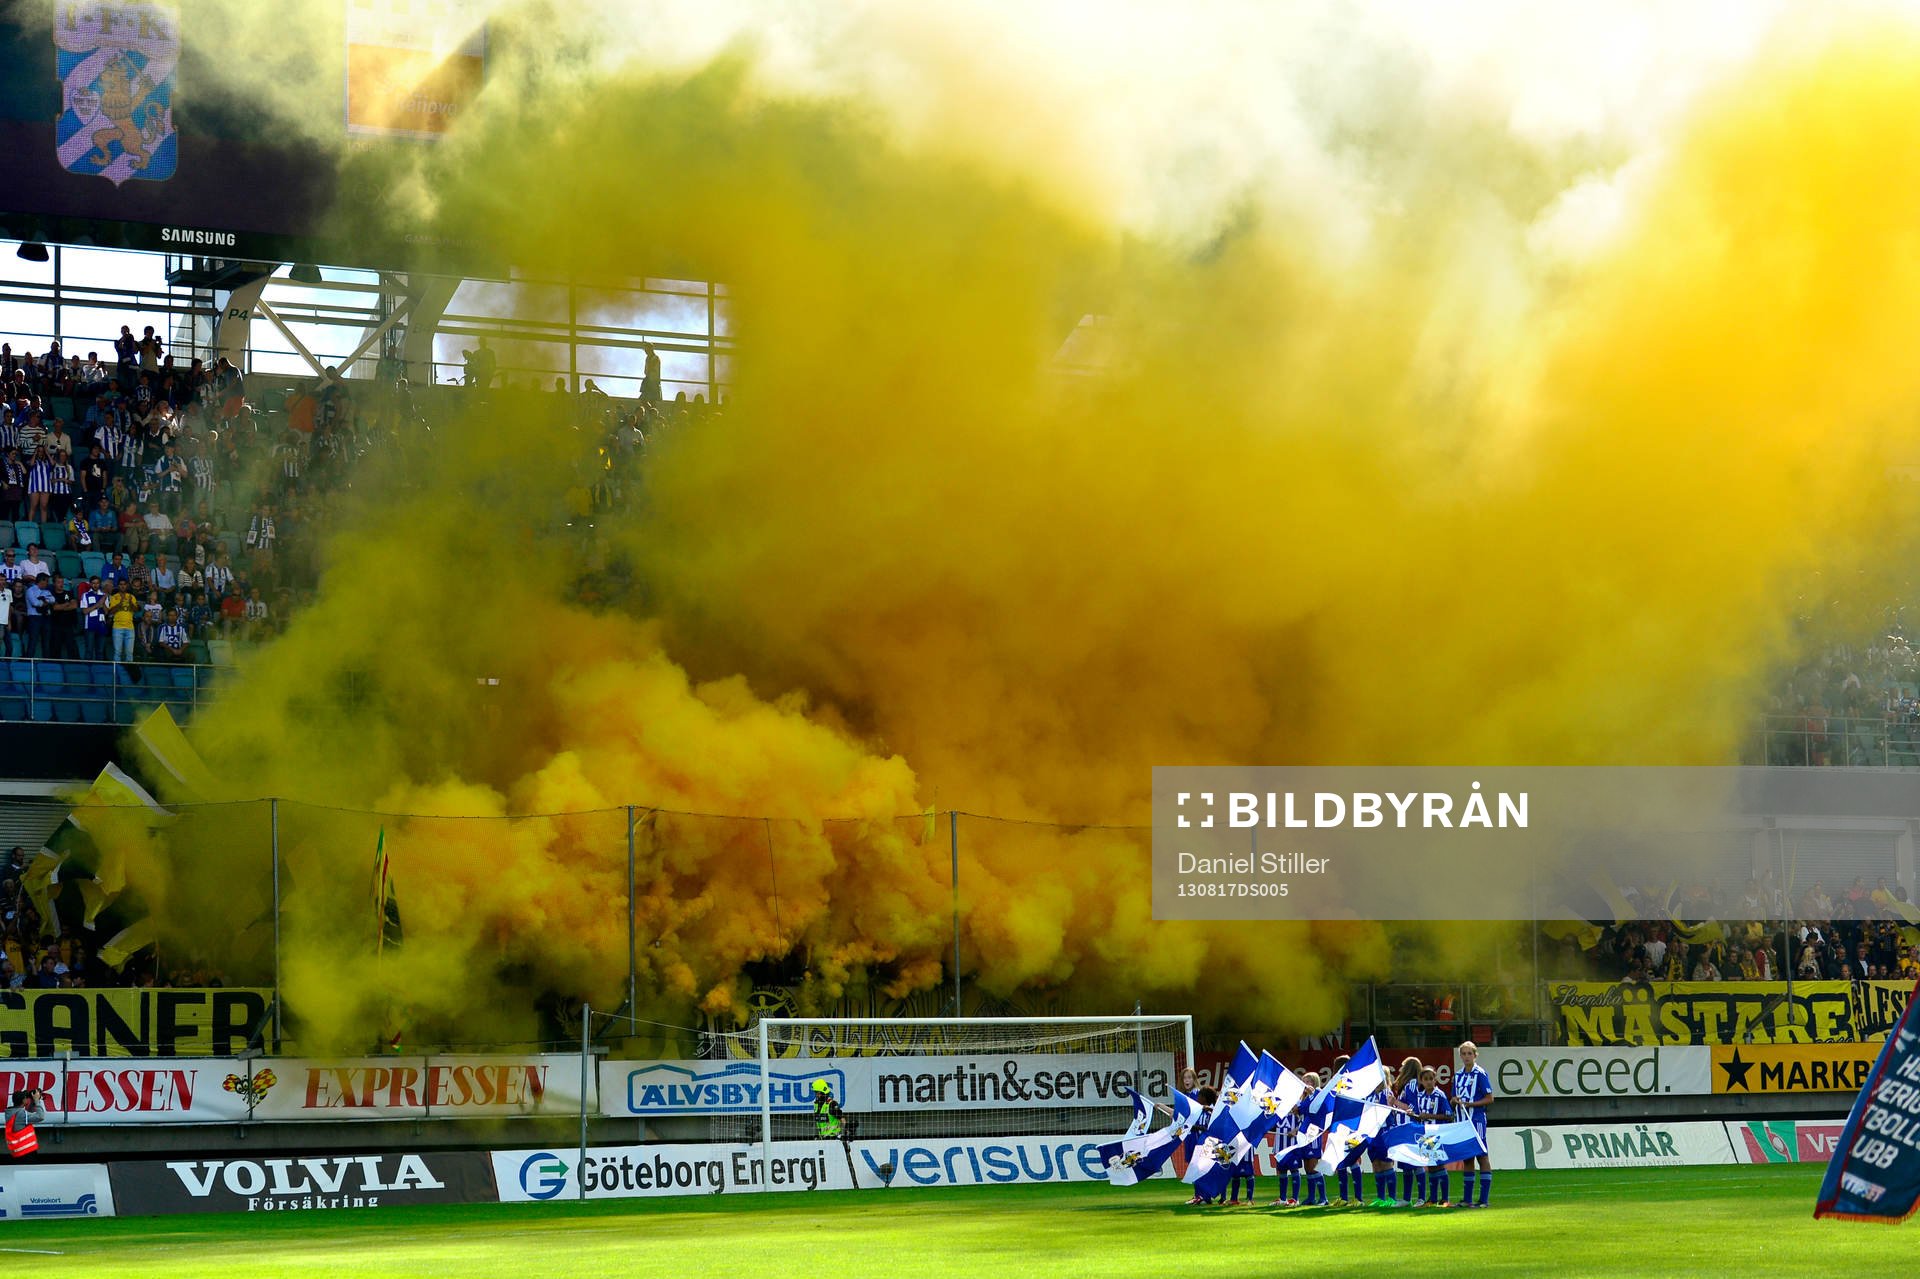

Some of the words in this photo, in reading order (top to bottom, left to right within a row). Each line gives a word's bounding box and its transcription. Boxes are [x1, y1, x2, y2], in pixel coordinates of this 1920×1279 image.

[161, 227, 236, 247] SAMSUNG
[227, 307, 249, 321] P4
[0, 1070, 198, 1112] PRESSEN
[302, 1066, 549, 1108] EXPRESSEN
[879, 1060, 1168, 1103] martin&servera
[1498, 1047, 1671, 1095] exceed.
[1761, 1060, 1874, 1090] MARKB
[1562, 1125, 1680, 1159] PRIMÄR
[166, 1154, 445, 1197] VOLVIA
[577, 1155, 725, 1194] Göteborg
[732, 1150, 827, 1190] Energi
[247, 1196, 379, 1211] Försäkring
